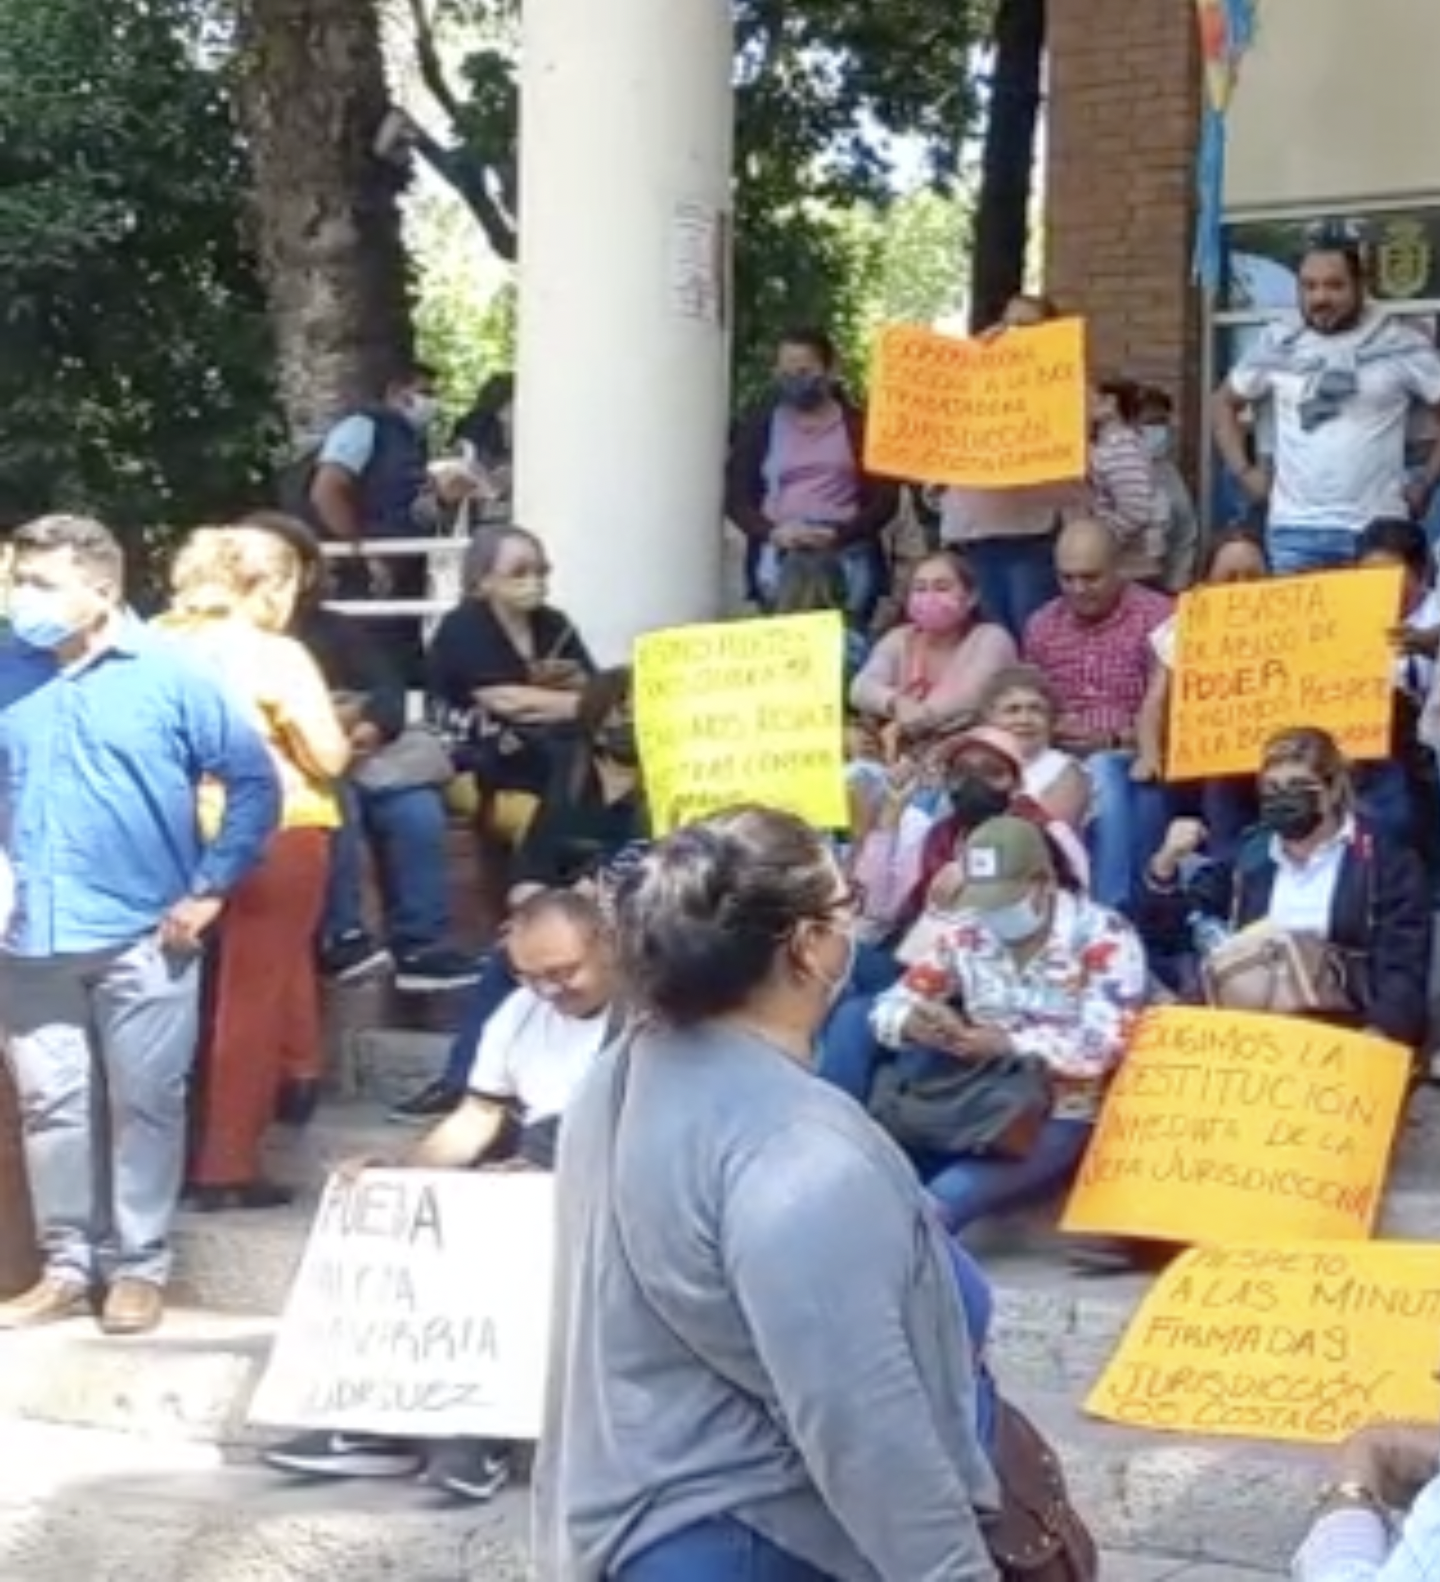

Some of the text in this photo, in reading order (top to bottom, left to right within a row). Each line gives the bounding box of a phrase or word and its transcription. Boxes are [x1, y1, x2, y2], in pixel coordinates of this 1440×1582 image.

[1299, 1043, 1345, 1074] LA
[1201, 1280, 1280, 1313] LAS
[1142, 1315, 1349, 1363] FIRMADAS
